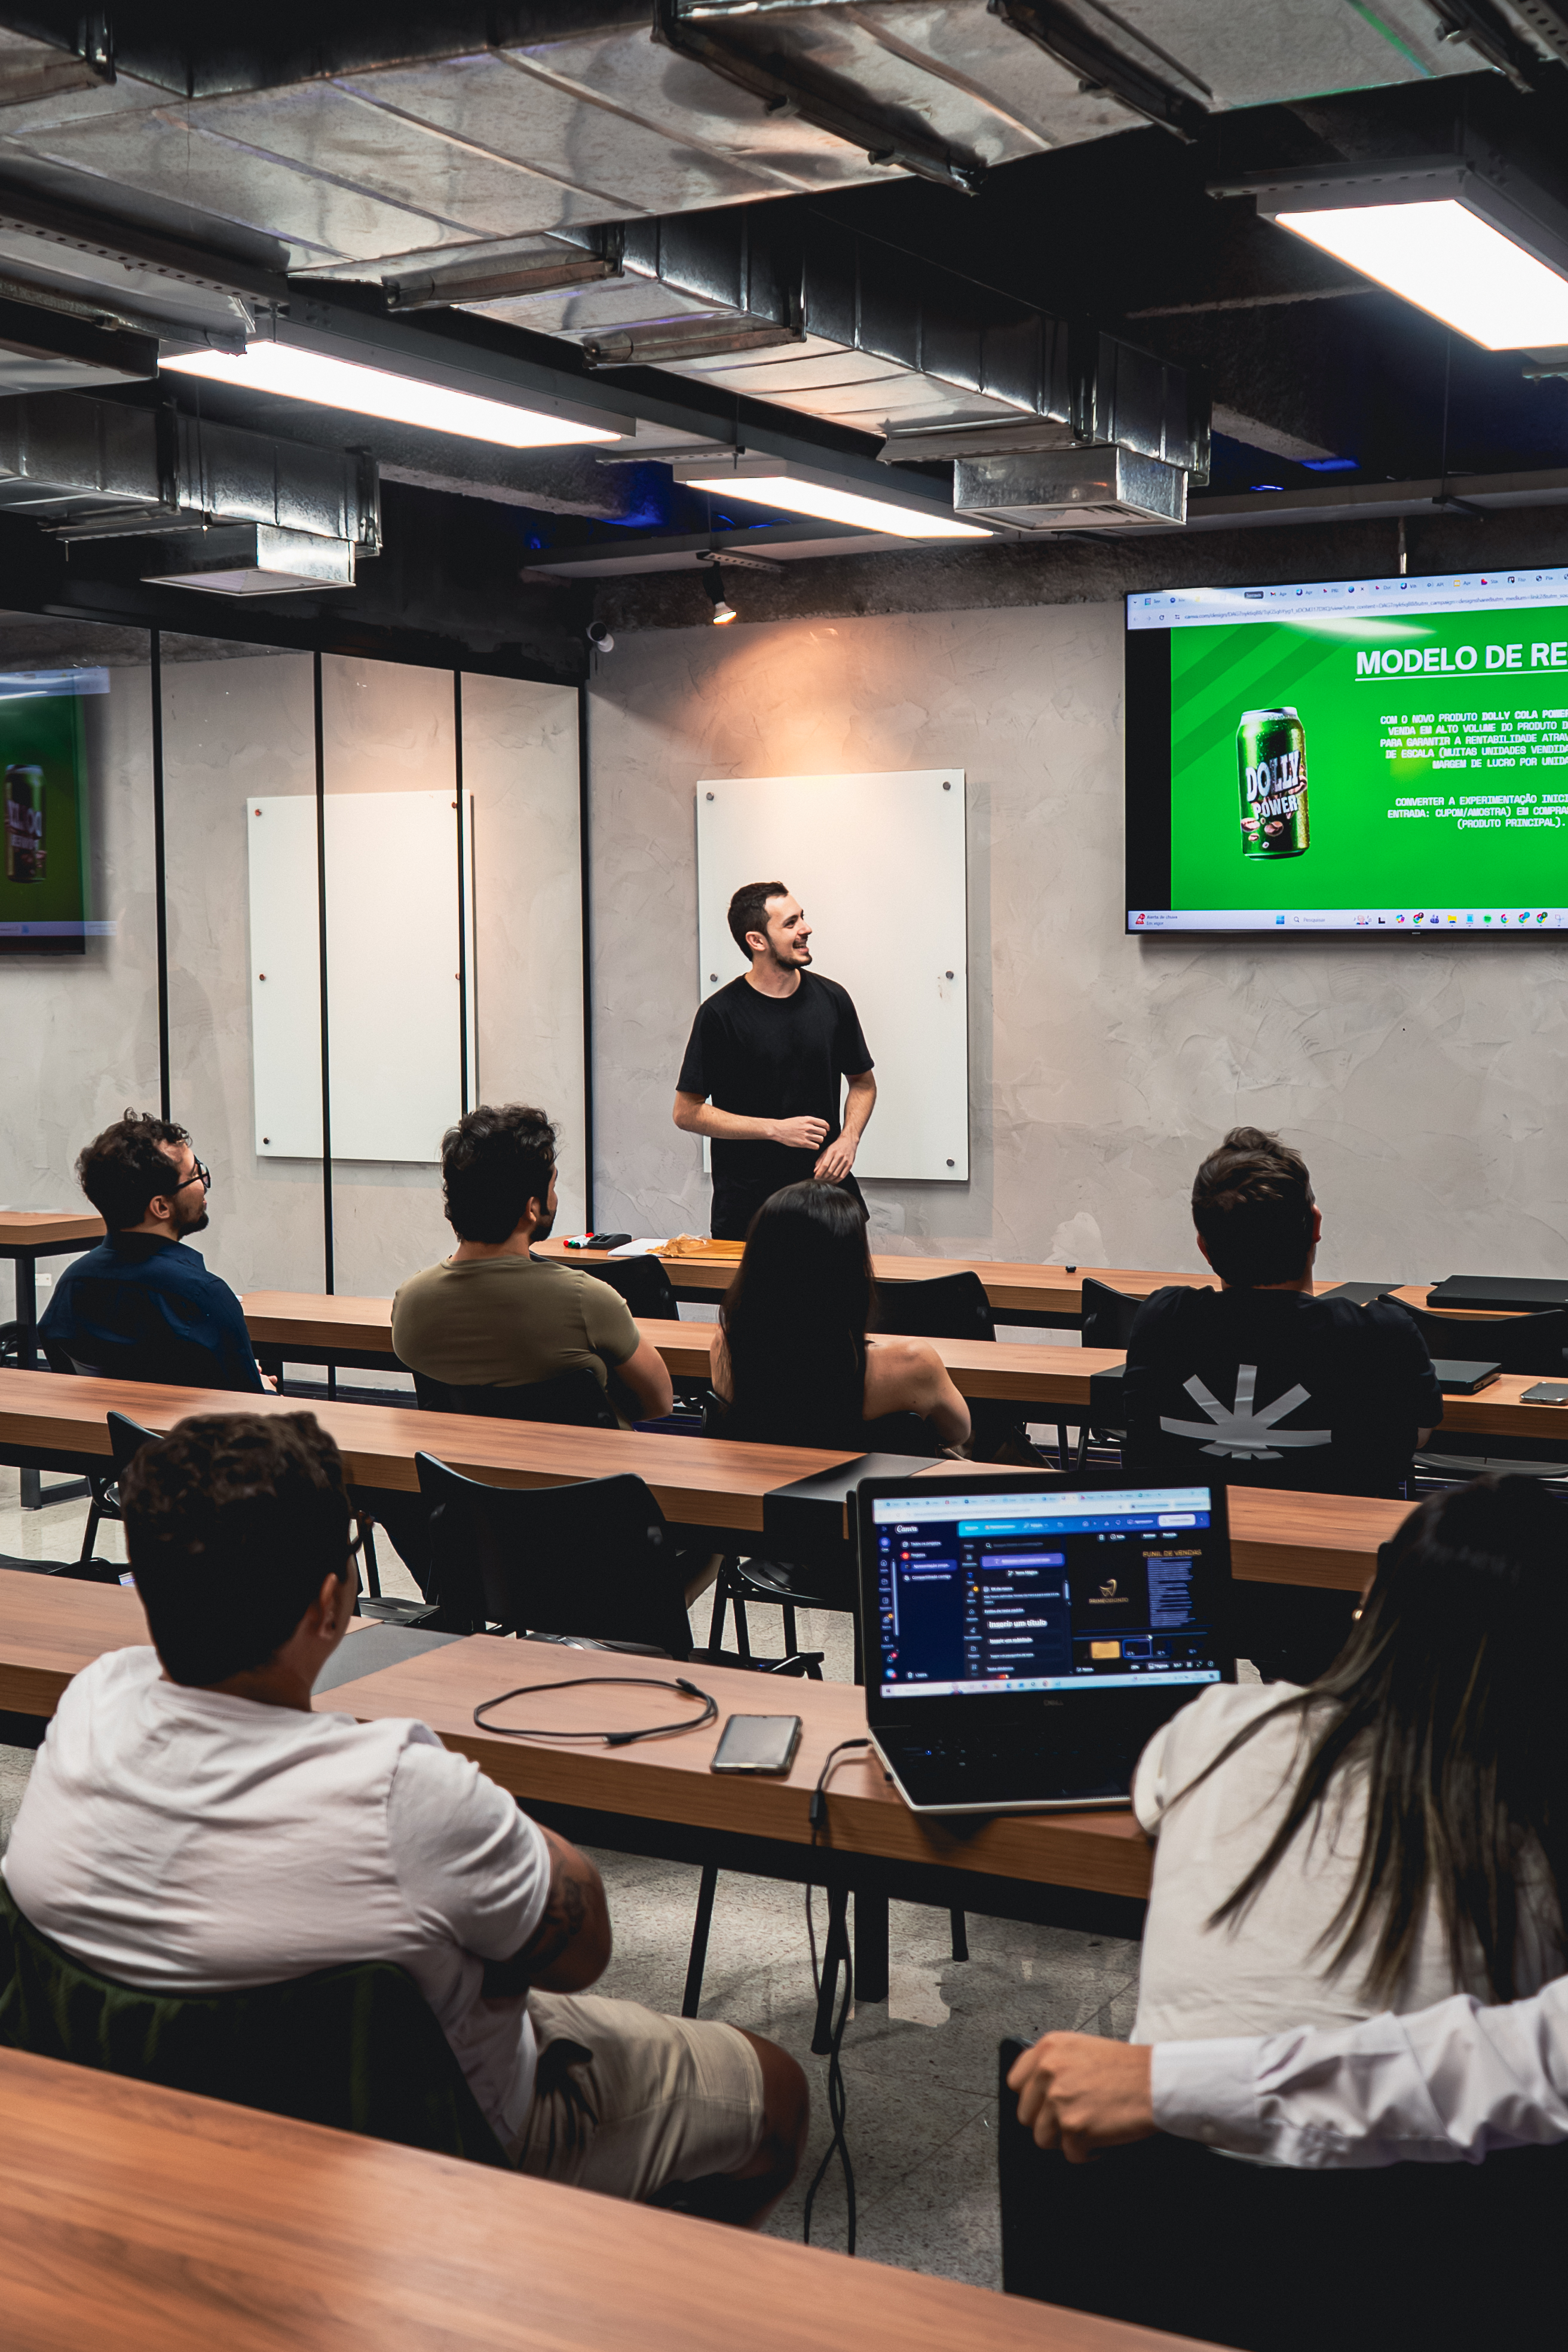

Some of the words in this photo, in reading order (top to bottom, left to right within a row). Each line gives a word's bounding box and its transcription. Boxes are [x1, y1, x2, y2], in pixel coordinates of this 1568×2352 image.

[1357, 645, 1478, 675] MODELO
[1486, 644, 1522, 668] DE
[1380, 716, 1397, 724] COM
[1401, 715, 1407, 724] O
[1412, 714, 1434, 723] NOVO
[1439, 713, 1477, 722] PRODUTO
[1482, 712, 1510, 721] DOLLY
[1515, 710, 1538, 719] COLA
[1388, 726, 1416, 735] VENDA
[1420, 725, 1432, 734] EM
[1436, 725, 1458, 733] ALTO
[1463, 724, 1495, 732] VOLUME
[1502, 723, 1512, 731] DO
[1518, 722, 1557, 730] PRODUTO
[1380, 739, 1402, 747] PARA
[1406, 737, 1450, 746] GARANTIR
[1466, 734, 1536, 744] RENTABILIDADE
[1386, 750, 1396, 758] DE
[1401, 749, 1434, 758] ESCALA
[1439, 747, 1477, 758] (MUITAS
[1482, 746, 1526, 755] UNIDADES
[1432, 760, 1466, 768] MARGEM
[1487, 758, 1515, 767] LUCRO
[1245, 750, 1300, 803] DOLLY
[1396, 797, 1444, 806] CONVERTER
[1460, 794, 1537, 805] EXPERIMENTAÇÃO
[1252, 795, 1298, 820] POWER
[1388, 809, 1429, 818] ENTRADA:
[1436, 806, 1511, 817] CUPOM/AMOSTRA)
[1458, 819, 1500, 829] (PRODUTO
[1506, 816, 1565, 828] PRINCIPAL).
[896, 1525, 918, 1533] Canva
